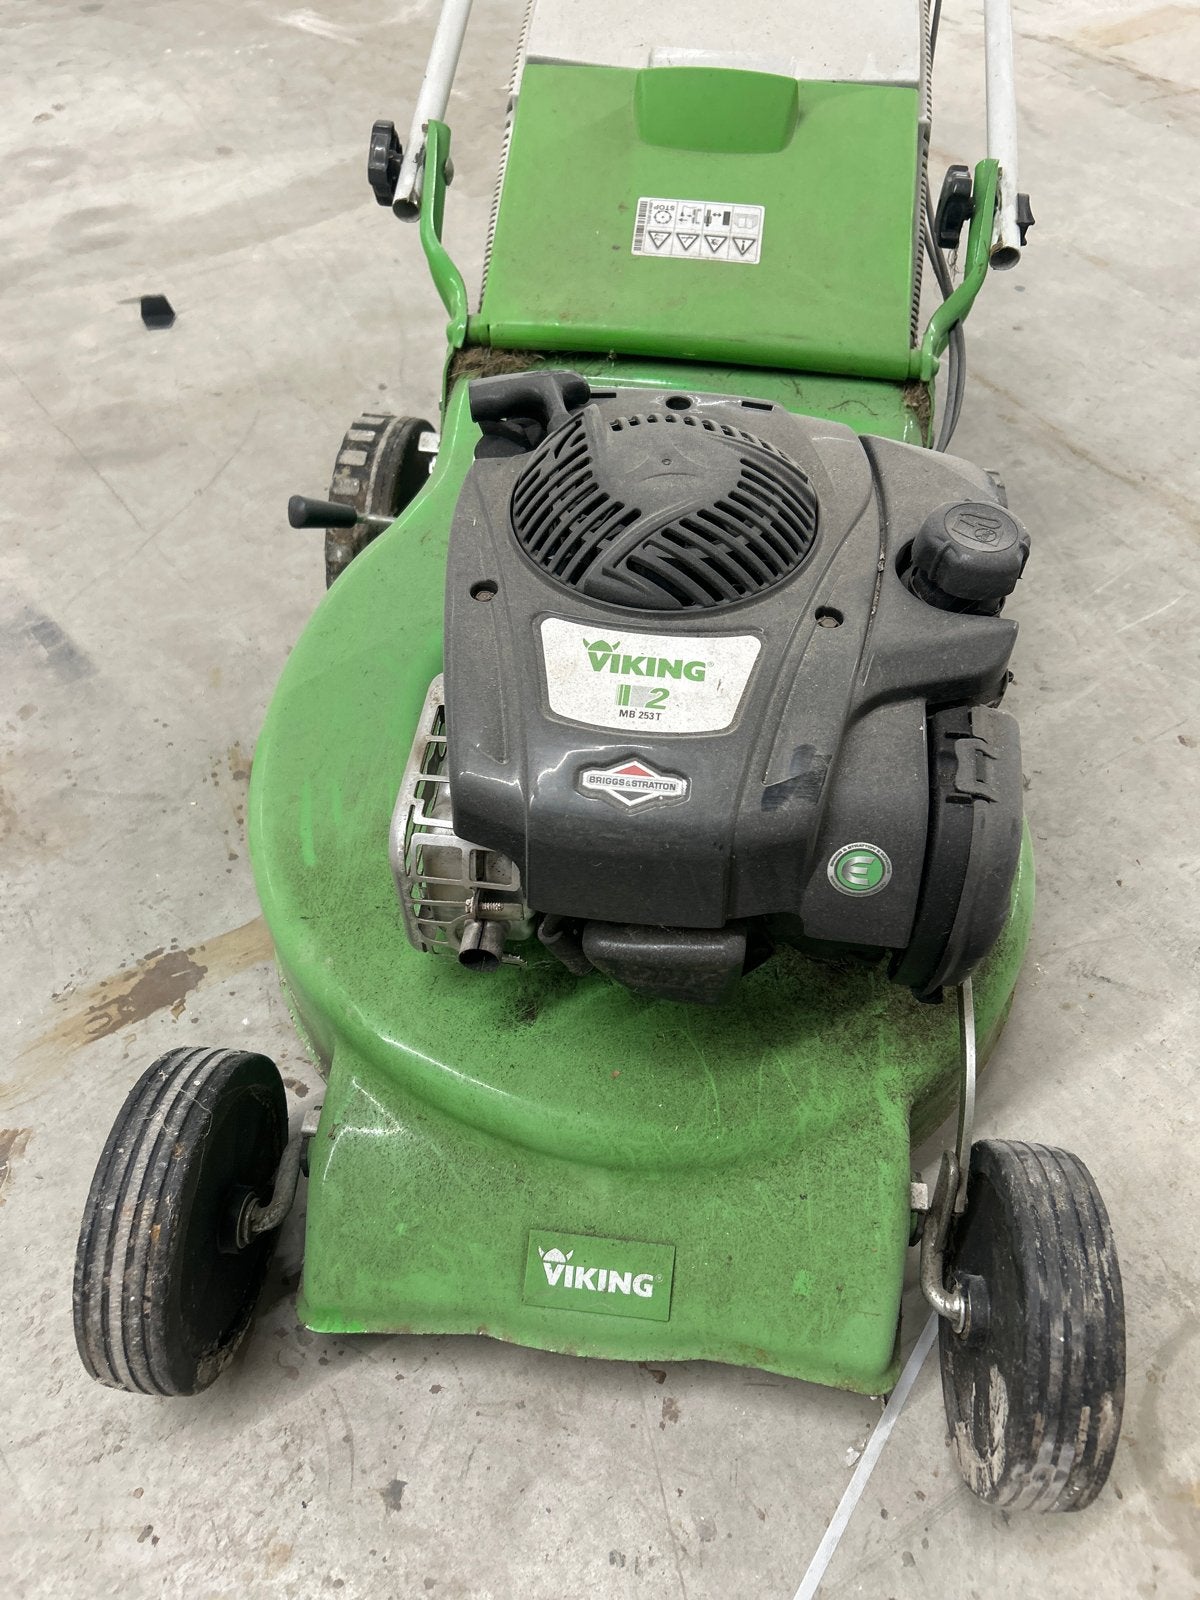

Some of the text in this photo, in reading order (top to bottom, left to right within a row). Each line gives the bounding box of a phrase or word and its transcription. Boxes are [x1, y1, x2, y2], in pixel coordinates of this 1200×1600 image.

[653, 204, 675, 212] STOP
[587, 651, 706, 682] VIKING
[619, 709, 636, 719] MB
[543, 1262, 654, 1298] VIKING
